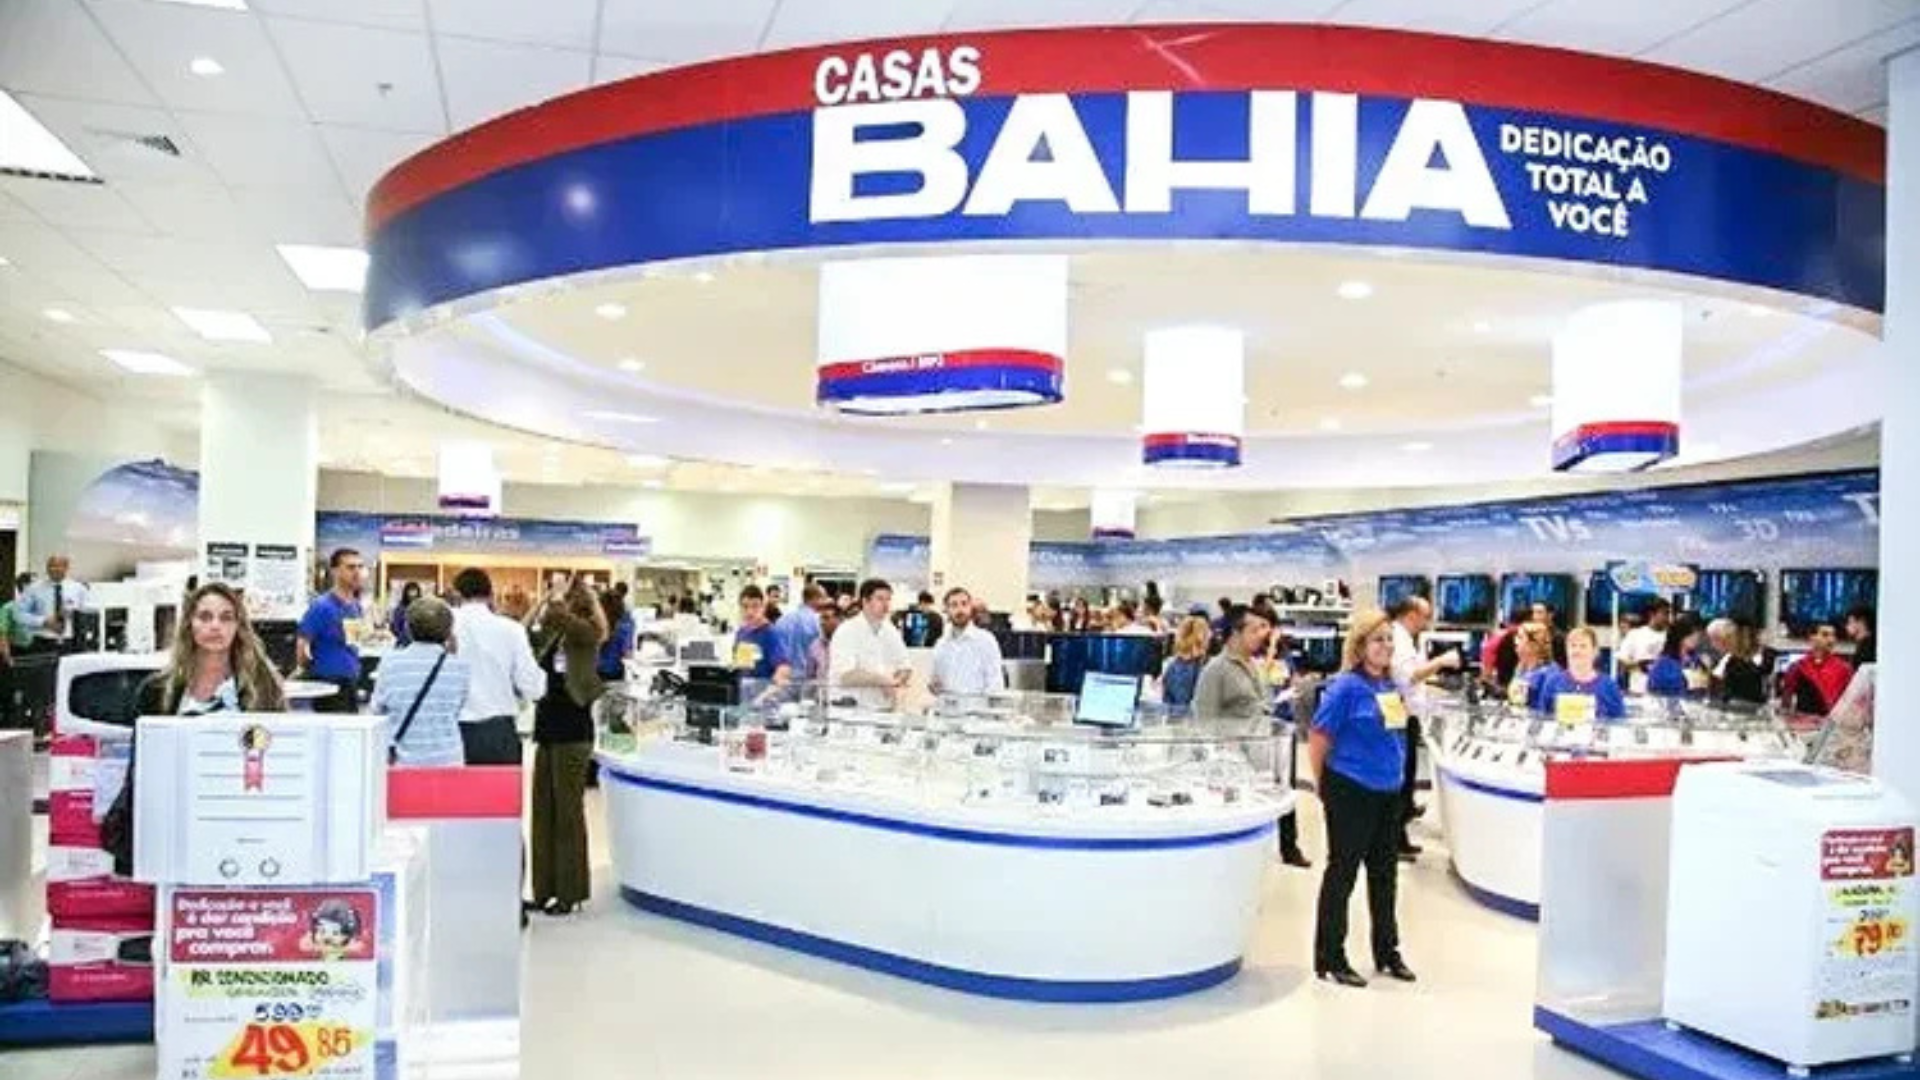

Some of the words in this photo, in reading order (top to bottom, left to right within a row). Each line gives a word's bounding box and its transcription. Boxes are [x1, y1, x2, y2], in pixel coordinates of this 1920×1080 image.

[815, 46, 982, 104] CASAS
[809, 90, 1512, 229] BAHIA
[1500, 124, 1670, 173] DEDICAÇÃO
[1525, 162, 1621, 199] TOTAL
[1625, 177, 1648, 204] A
[1548, 201, 1629, 238] VOCÊ
[1518, 513, 1594, 541] TVs
[176, 927, 208, 944] pra
[231, 1023, 311, 1076] 49
